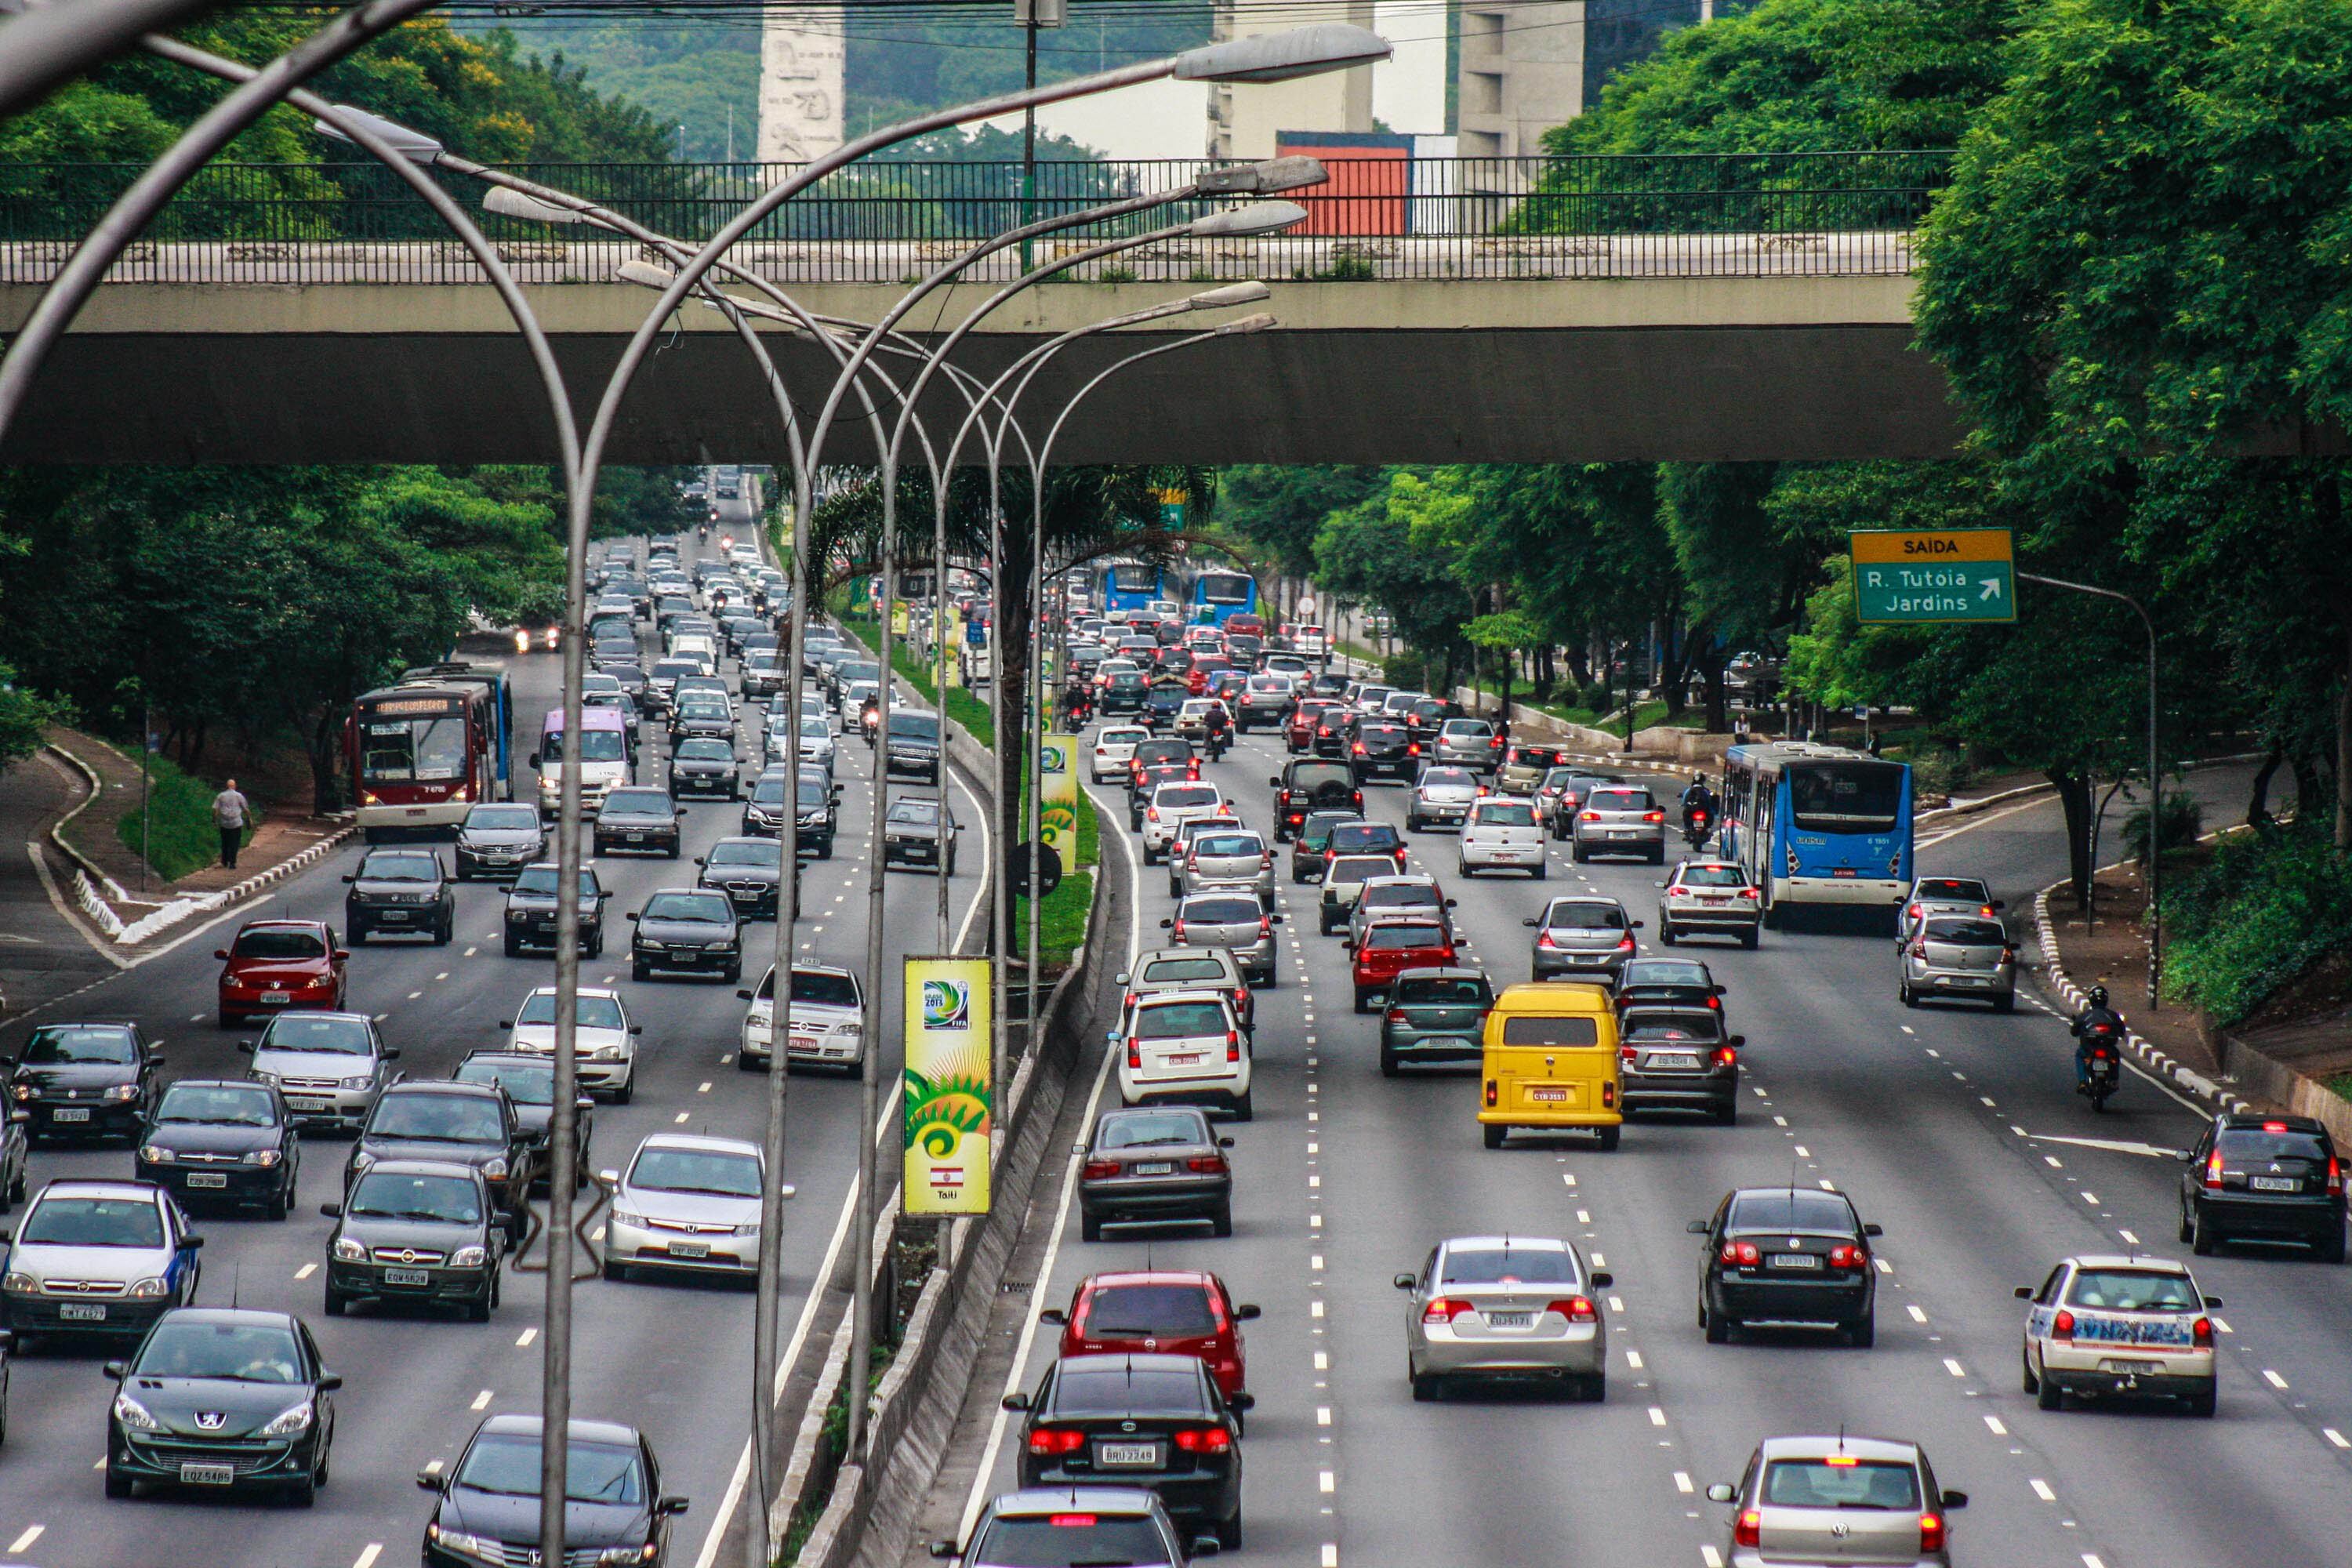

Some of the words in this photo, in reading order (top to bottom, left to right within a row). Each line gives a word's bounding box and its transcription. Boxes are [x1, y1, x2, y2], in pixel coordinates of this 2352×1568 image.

[1904, 537, 1958, 554] SAÍDA
[1867, 572, 1889, 587] R.
[1899, 569, 1966, 587] Tutóia
[1886, 594, 1968, 612] Jardins
